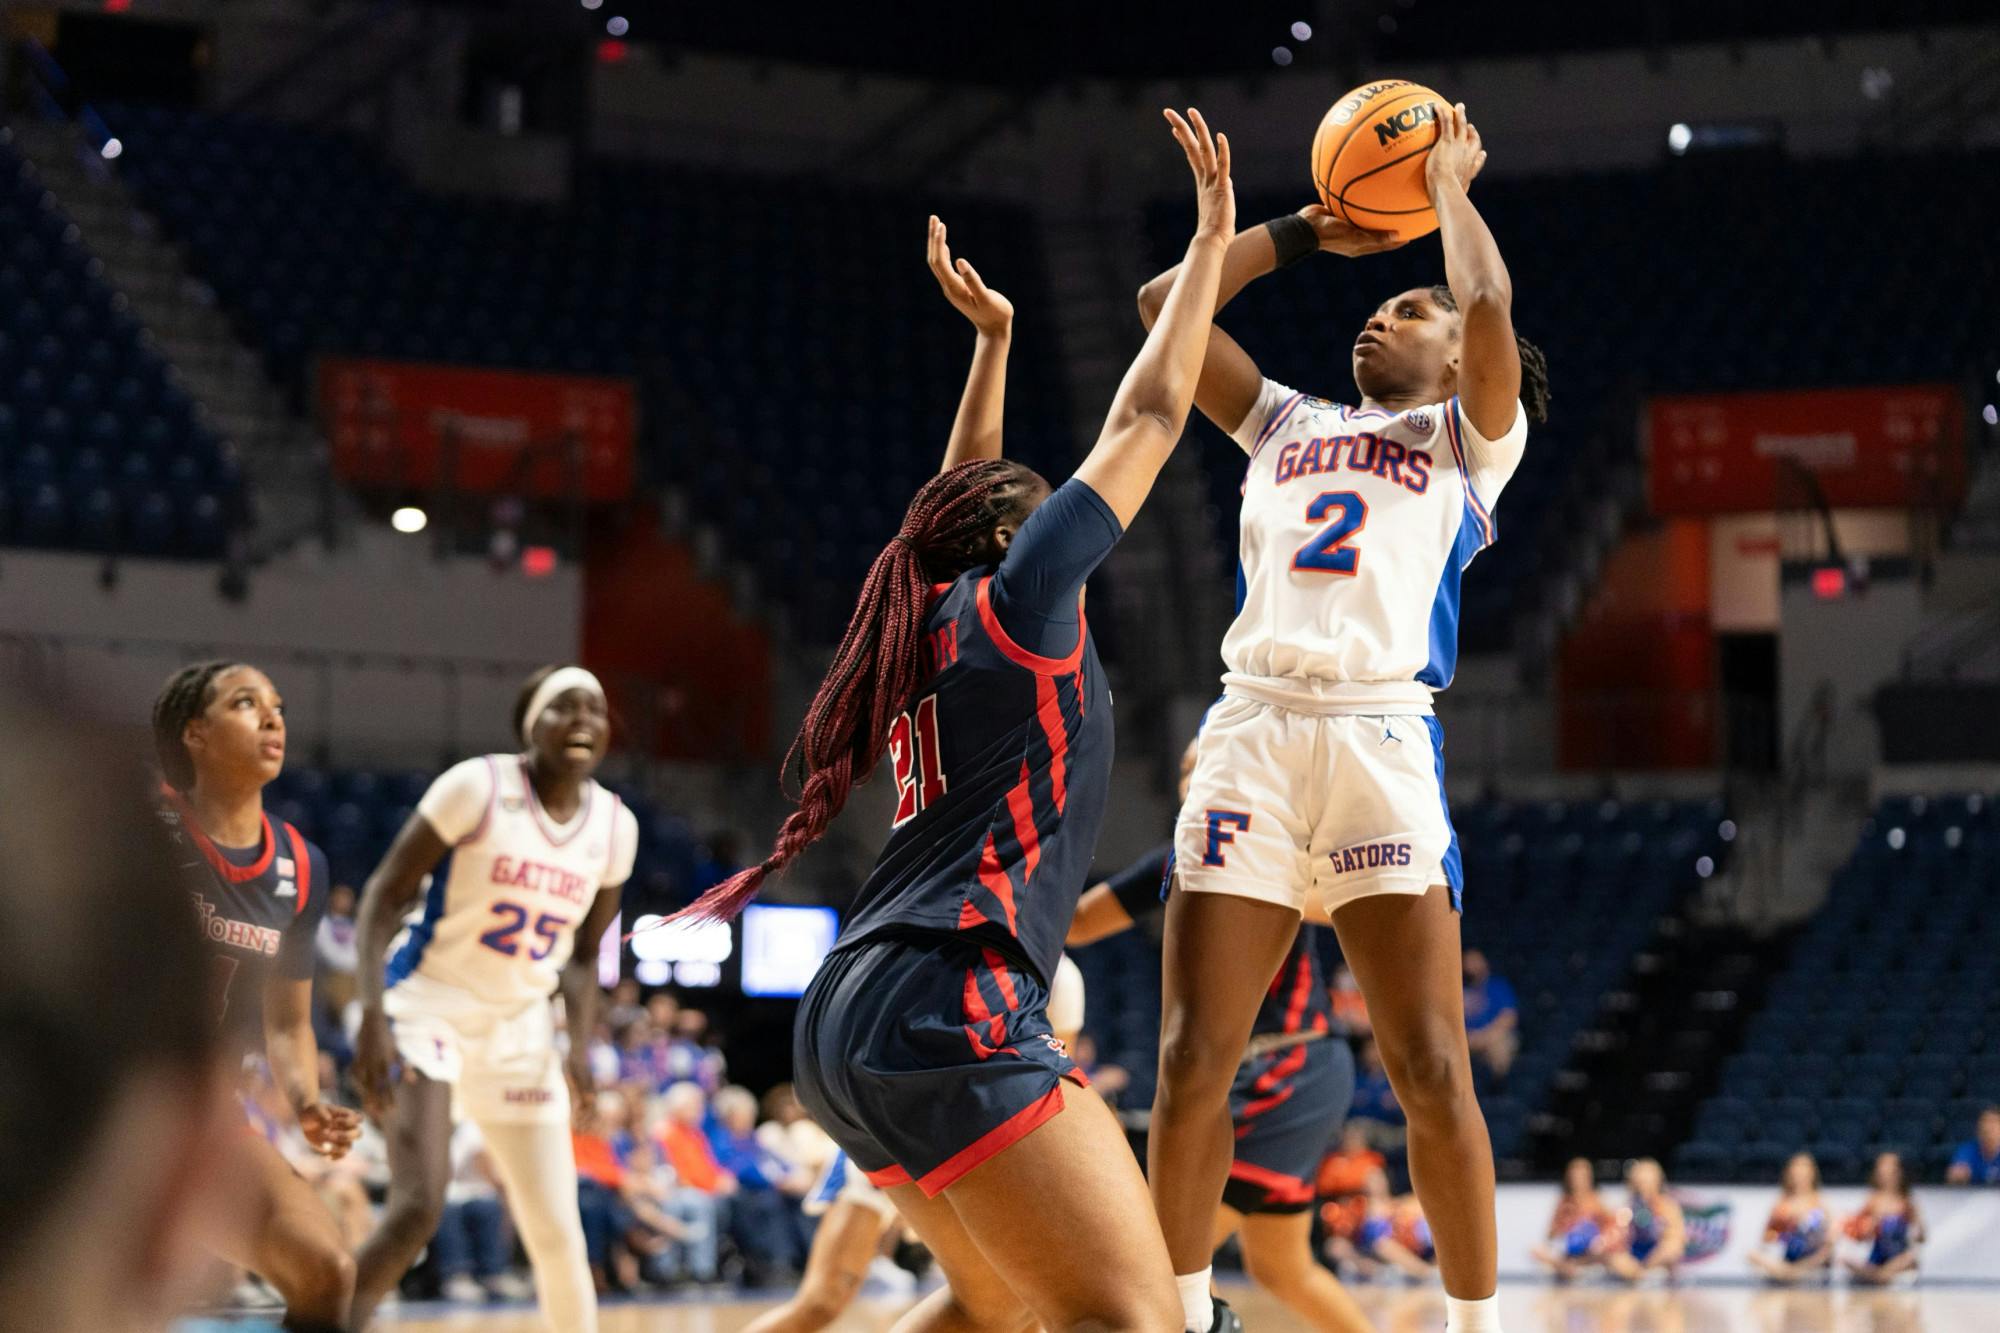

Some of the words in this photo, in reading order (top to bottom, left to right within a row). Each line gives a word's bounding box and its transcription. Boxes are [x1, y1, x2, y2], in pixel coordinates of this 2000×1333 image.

[1275, 432, 1433, 496] GATORS
[1290, 490, 1369, 576] 2
[888, 693, 947, 829] 21
[1201, 809, 1251, 868] F
[1329, 843, 1411, 874] GATORS
[490, 854, 588, 906] GATORS
[478, 899, 571, 962] 25
